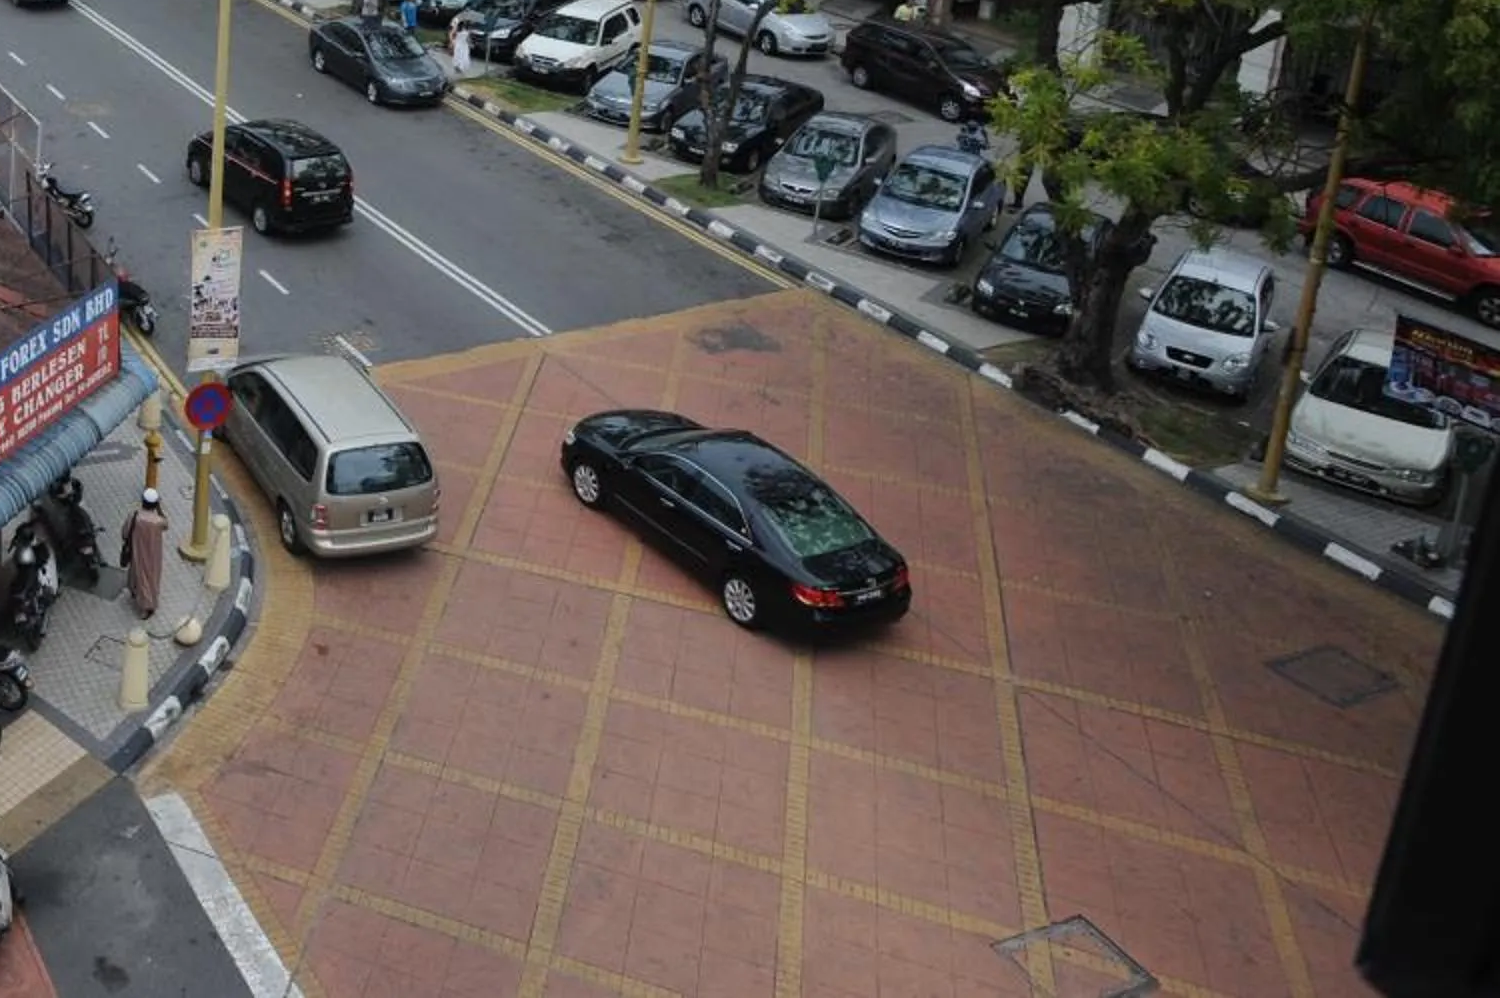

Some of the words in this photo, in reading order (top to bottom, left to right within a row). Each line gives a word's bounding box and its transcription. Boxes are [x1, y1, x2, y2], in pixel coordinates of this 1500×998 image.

[0, 330, 49, 381] FOREX
[52, 307, 81, 343] SDN
[85, 287, 114, 322] BHD
[11, 338, 87, 405] BERLESEN
[13, 363, 85, 425] CHANGER
